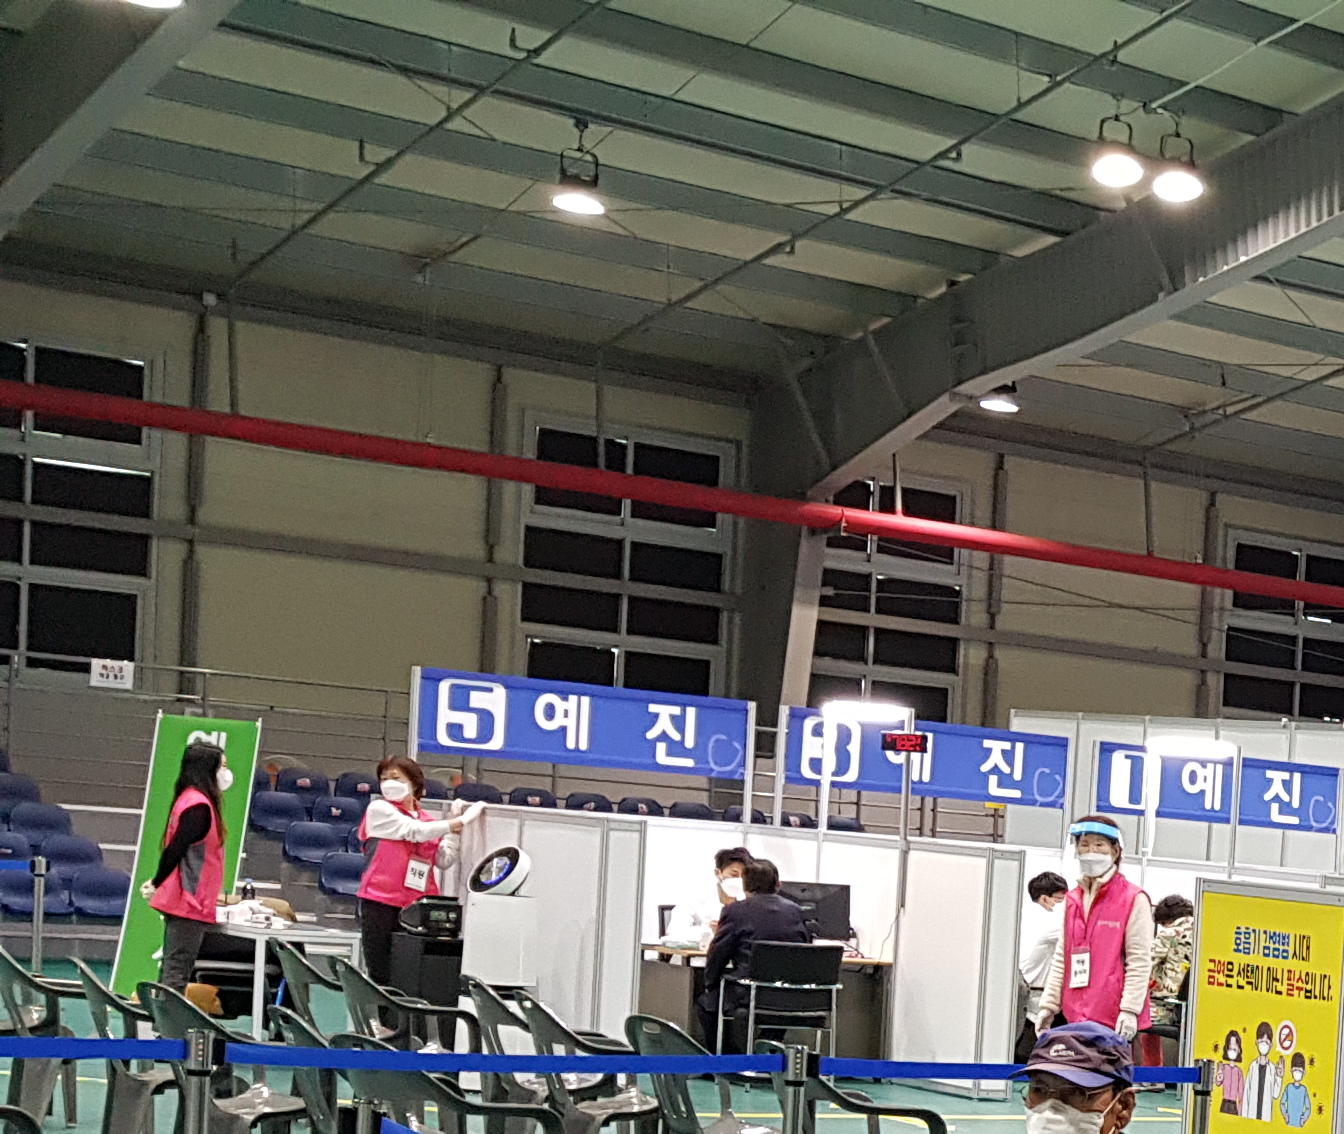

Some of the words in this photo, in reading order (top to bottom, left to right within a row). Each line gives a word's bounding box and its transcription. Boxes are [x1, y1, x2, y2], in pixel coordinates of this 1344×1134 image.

[441, 680, 502, 748] 5
[1292, 933, 1311, 962] 시대
[1207, 958, 1235, 988] 금연은
[1236, 962, 1264, 992] 선택이
[1266, 966, 1284, 995] 아닌
[1286, 969, 1333, 1003] 필수입니다.
